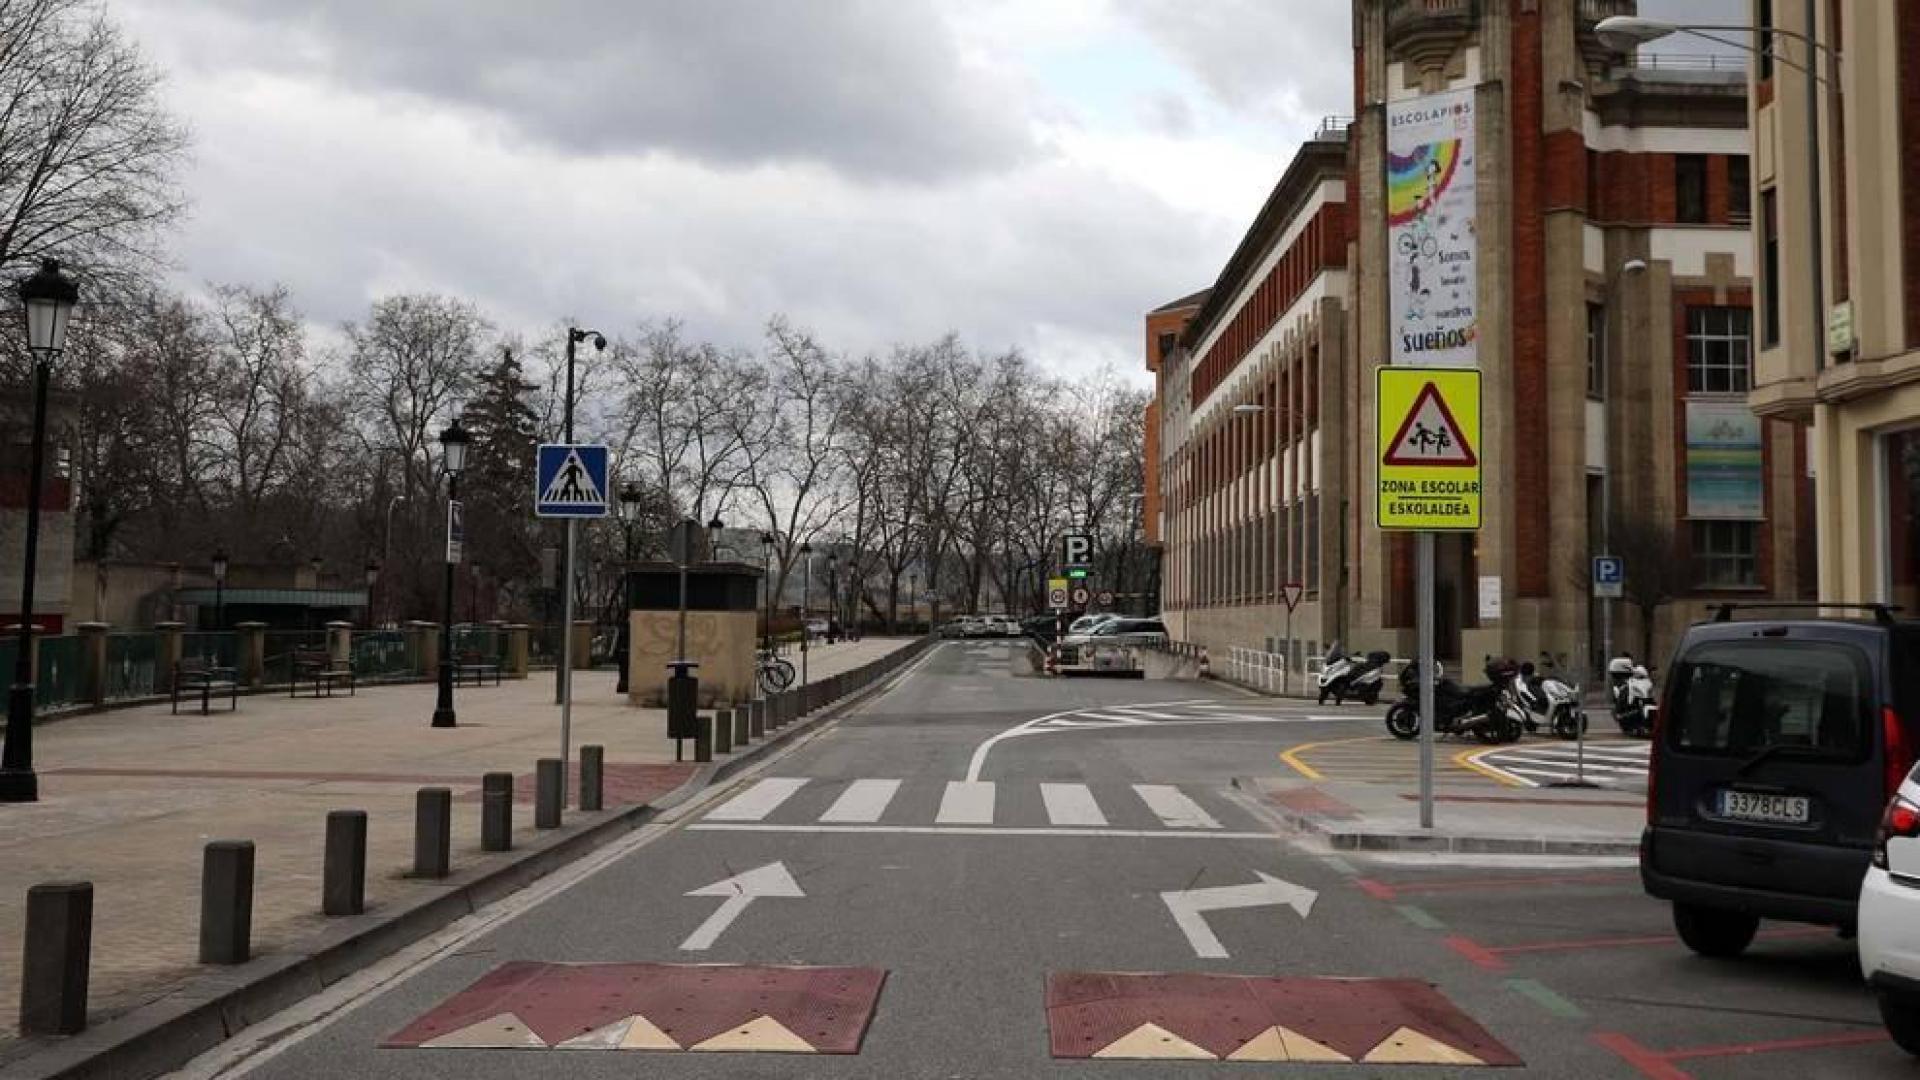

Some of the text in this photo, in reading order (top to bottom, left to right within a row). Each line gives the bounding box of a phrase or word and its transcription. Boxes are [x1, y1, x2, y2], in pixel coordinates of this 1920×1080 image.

[1403, 326, 1467, 353] sueños
[1382, 481, 1479, 494] ZONA ESCOLAR
[1390, 503, 1470, 515] ESKOLALDEA
[1067, 537, 1088, 562] P
[1601, 561, 1616, 581] P
[1730, 794, 1804, 817] 3378CLS
